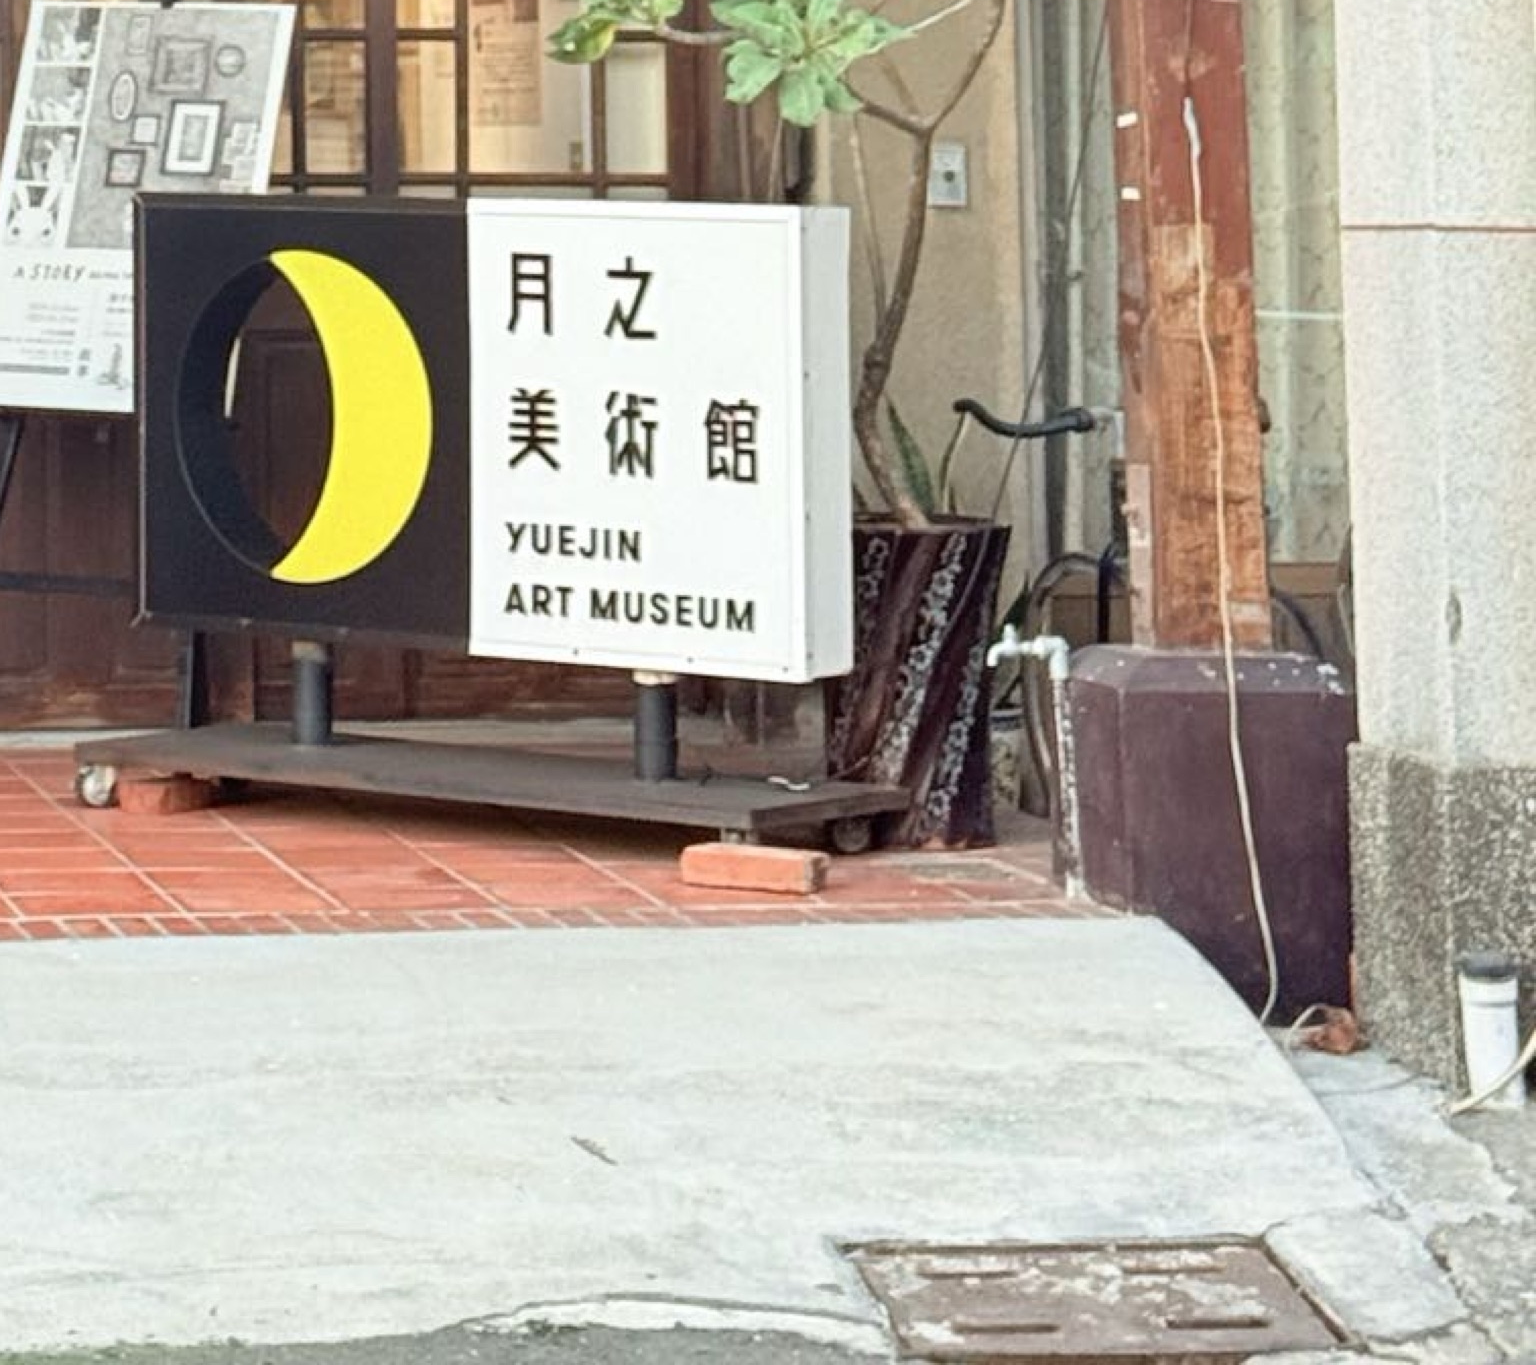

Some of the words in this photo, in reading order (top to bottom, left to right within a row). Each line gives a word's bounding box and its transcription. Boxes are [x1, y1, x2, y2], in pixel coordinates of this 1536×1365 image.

[507, 252, 657, 340] 月之
[507, 387, 760, 485] 美術館
[505, 521, 643, 563] YUEJIN
[504, 583, 574, 618] ART
[590, 588, 756, 633] MUSEUM
